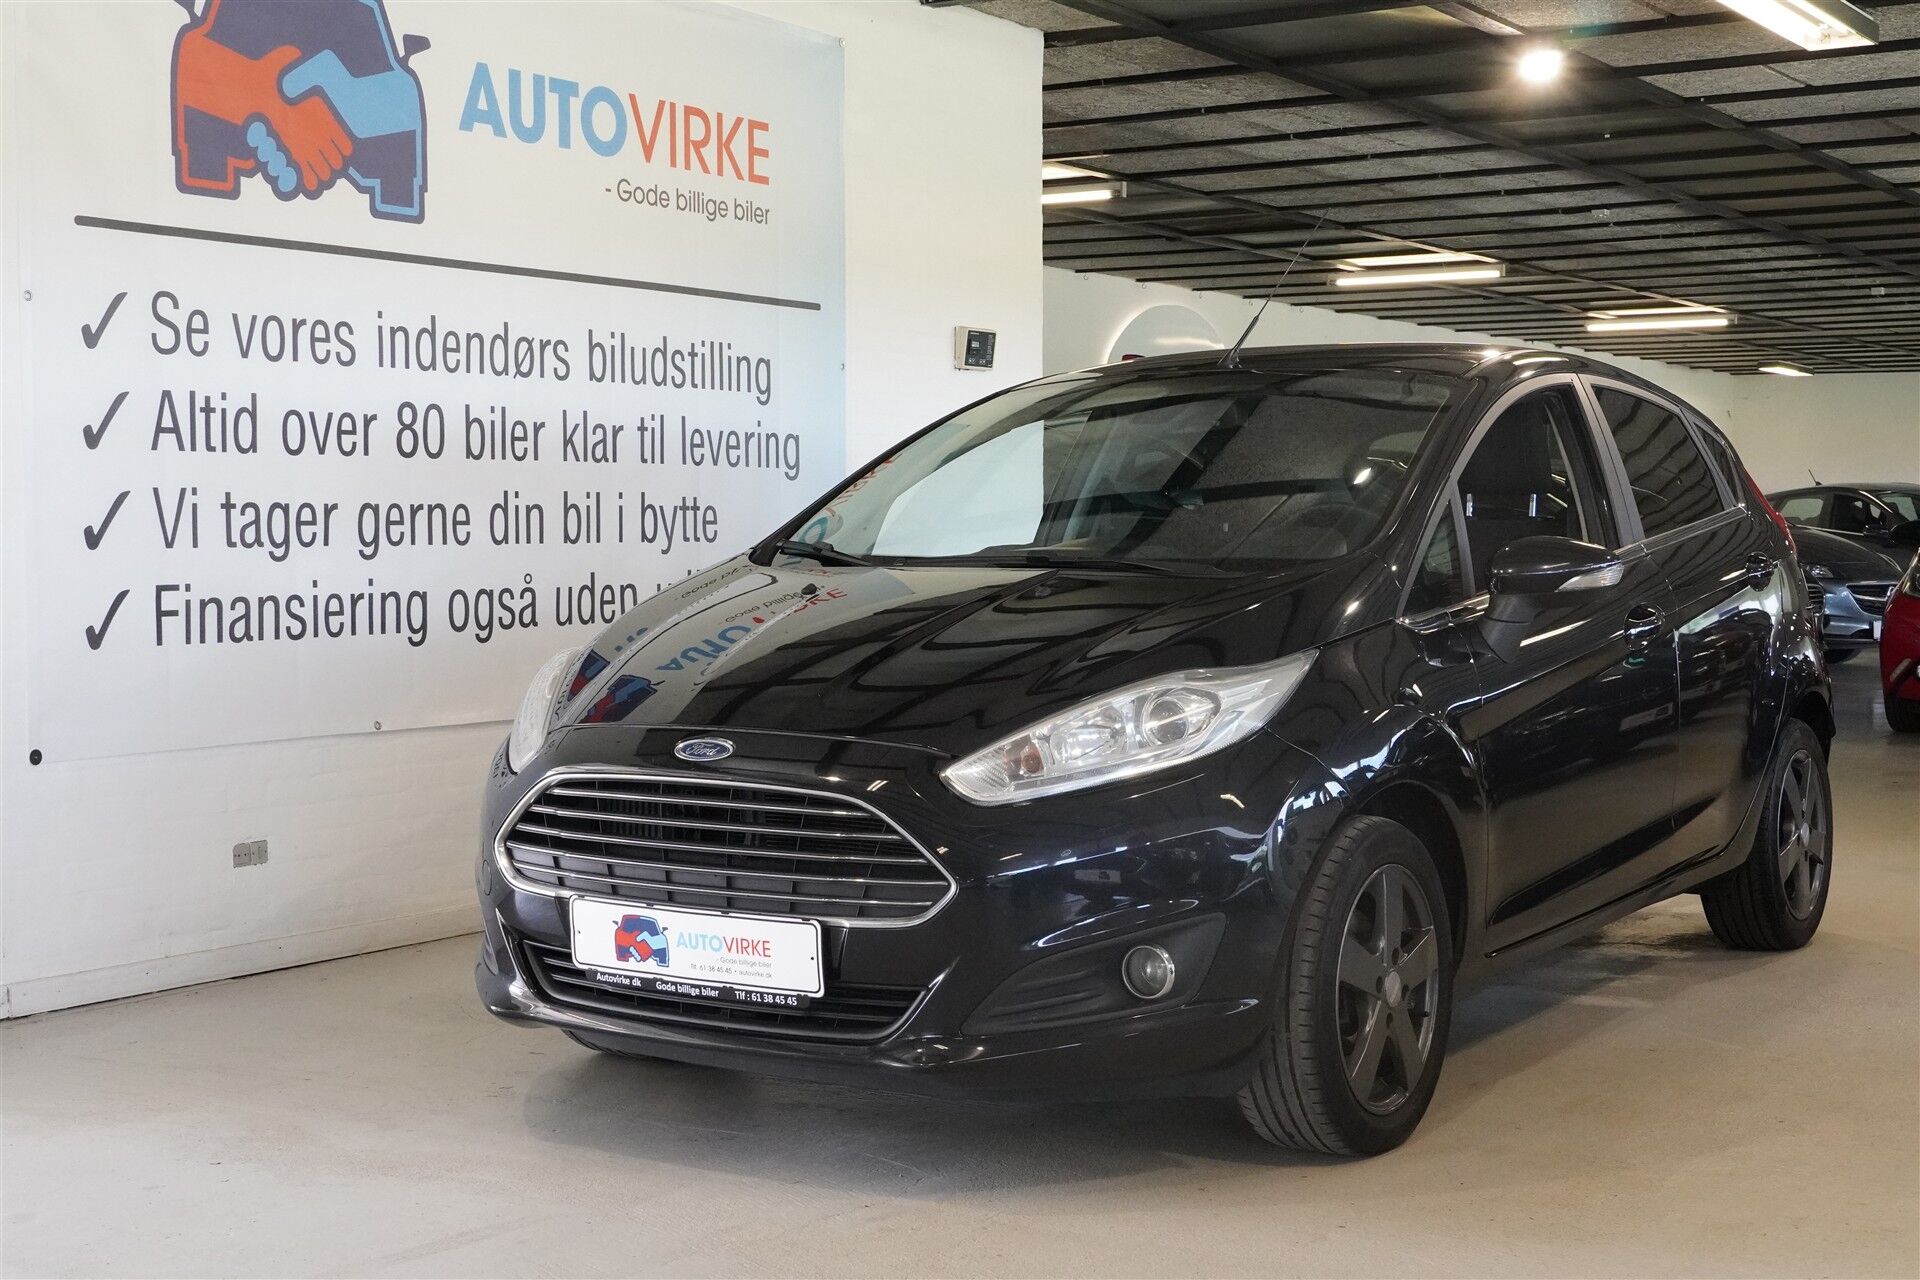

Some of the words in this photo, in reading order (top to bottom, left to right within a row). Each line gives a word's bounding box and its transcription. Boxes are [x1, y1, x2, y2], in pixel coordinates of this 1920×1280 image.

[459, 62, 770, 186] AUTOVIRKE
[616, 178, 670, 209] Gode
[676, 187, 729, 222] billige
[734, 198, 770, 225] biler
[151, 290, 210, 358] Se
[231, 312, 357, 368] vores
[377, 311, 571, 382] indendørs
[588, 328, 772, 406] biludstilling
[150, 389, 258, 455] Altid
[281, 409, 378, 459] over
[395, 400, 446, 461] 80
[464, 403, 546, 462] biler
[562, 409, 625, 464] klar
[636, 413, 666, 466] til
[681, 415, 801, 482] levering
[152, 486, 199, 550] Vi
[220, 491, 339, 563] tager
[357, 502, 471, 561] gerne
[489, 489, 545, 546] din
[563, 490, 601, 545] bil
[618, 491, 625, 544] i
[640, 491, 718, 556] bytte
[154, 583, 428, 648] Finansiering
[448, 573, 540, 644] også
[555, 572, 638, 627] uden
[686, 742, 721, 756] Ford
[676, 931, 771, 958] AUTOVIRKE
[720, 956, 737, 965] Gode
[725, 967, 733, 975] 45
[596, 972, 631, 986] Autovirke
[632, 977, 642, 987] dk
[656, 981, 676, 992] Gode
[677, 984, 700, 996] billige
[701, 987, 719, 998] biler
[735, 991, 746, 1000] Tlf
[751, 992, 762, 1002] 61
[763, 993, 774, 1003] 38
[775, 995, 785, 1004] 45
[786, 996, 798, 1006] 45
